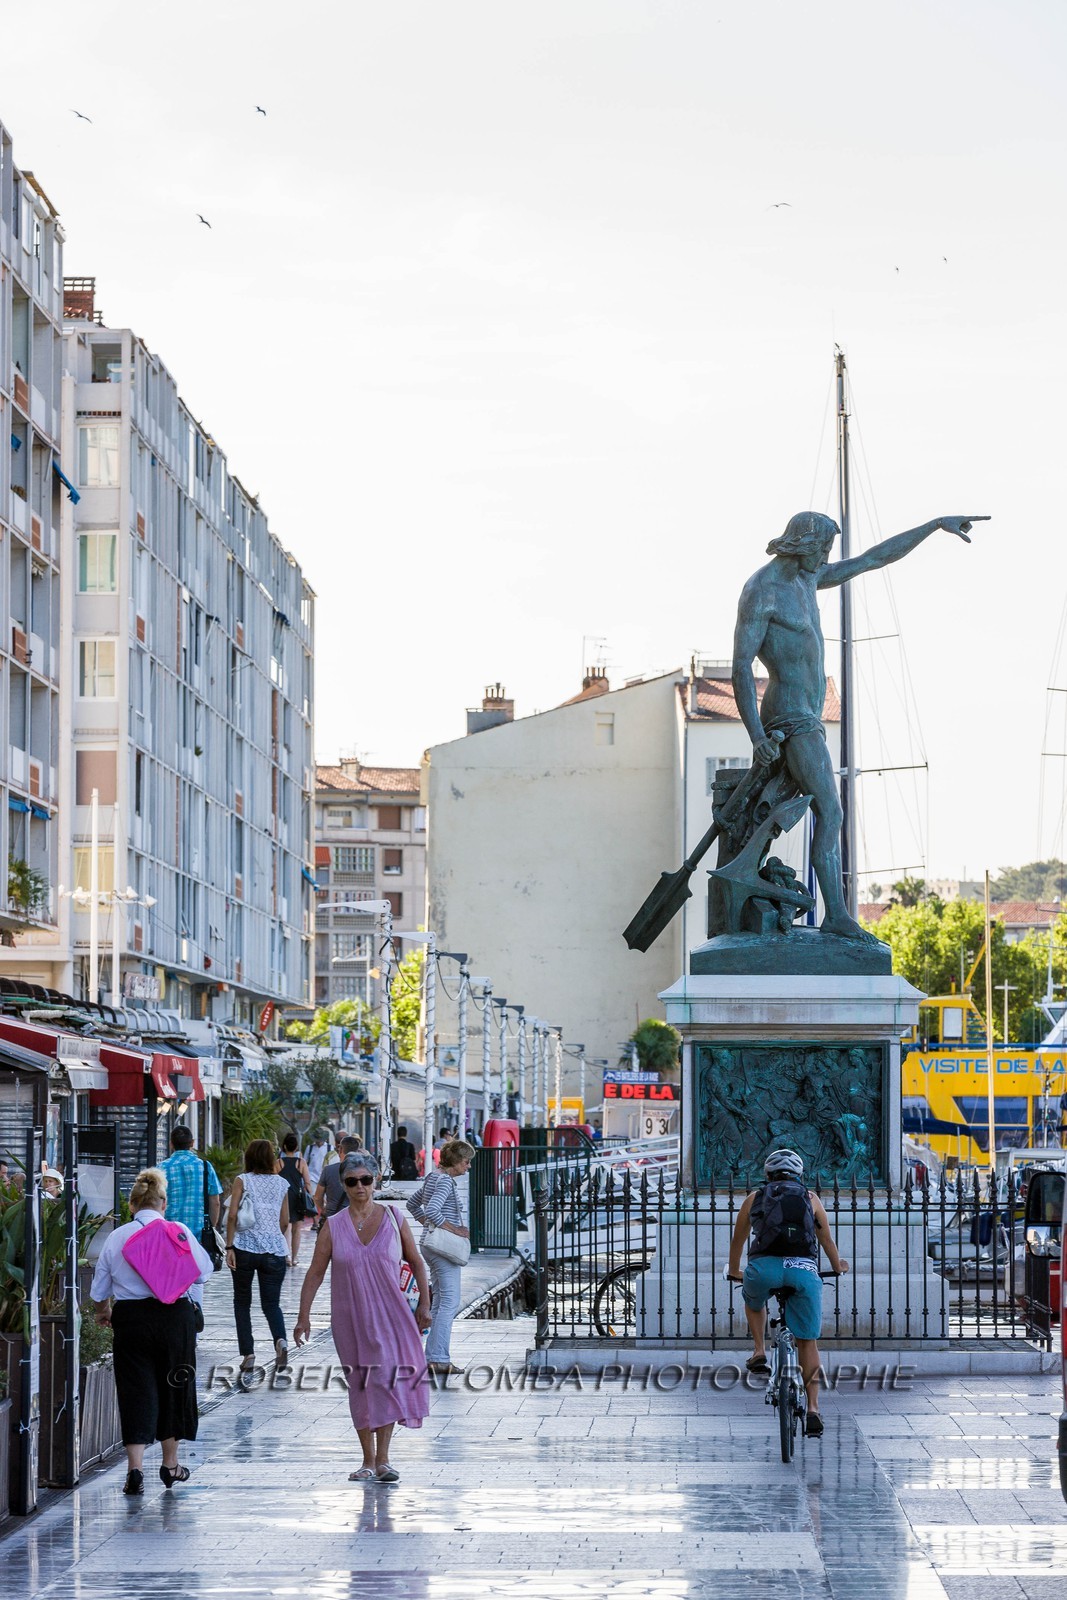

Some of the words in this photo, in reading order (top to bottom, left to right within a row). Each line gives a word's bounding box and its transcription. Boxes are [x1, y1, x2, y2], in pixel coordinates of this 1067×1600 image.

[919, 1058, 989, 1073] VISITE
[996, 1058, 1028, 1074] DE
[604, 1083, 617, 1098] E
[621, 1083, 646, 1099] DE
[649, 1084, 674, 1100] LA
[645, 1117, 653, 1135] 9
